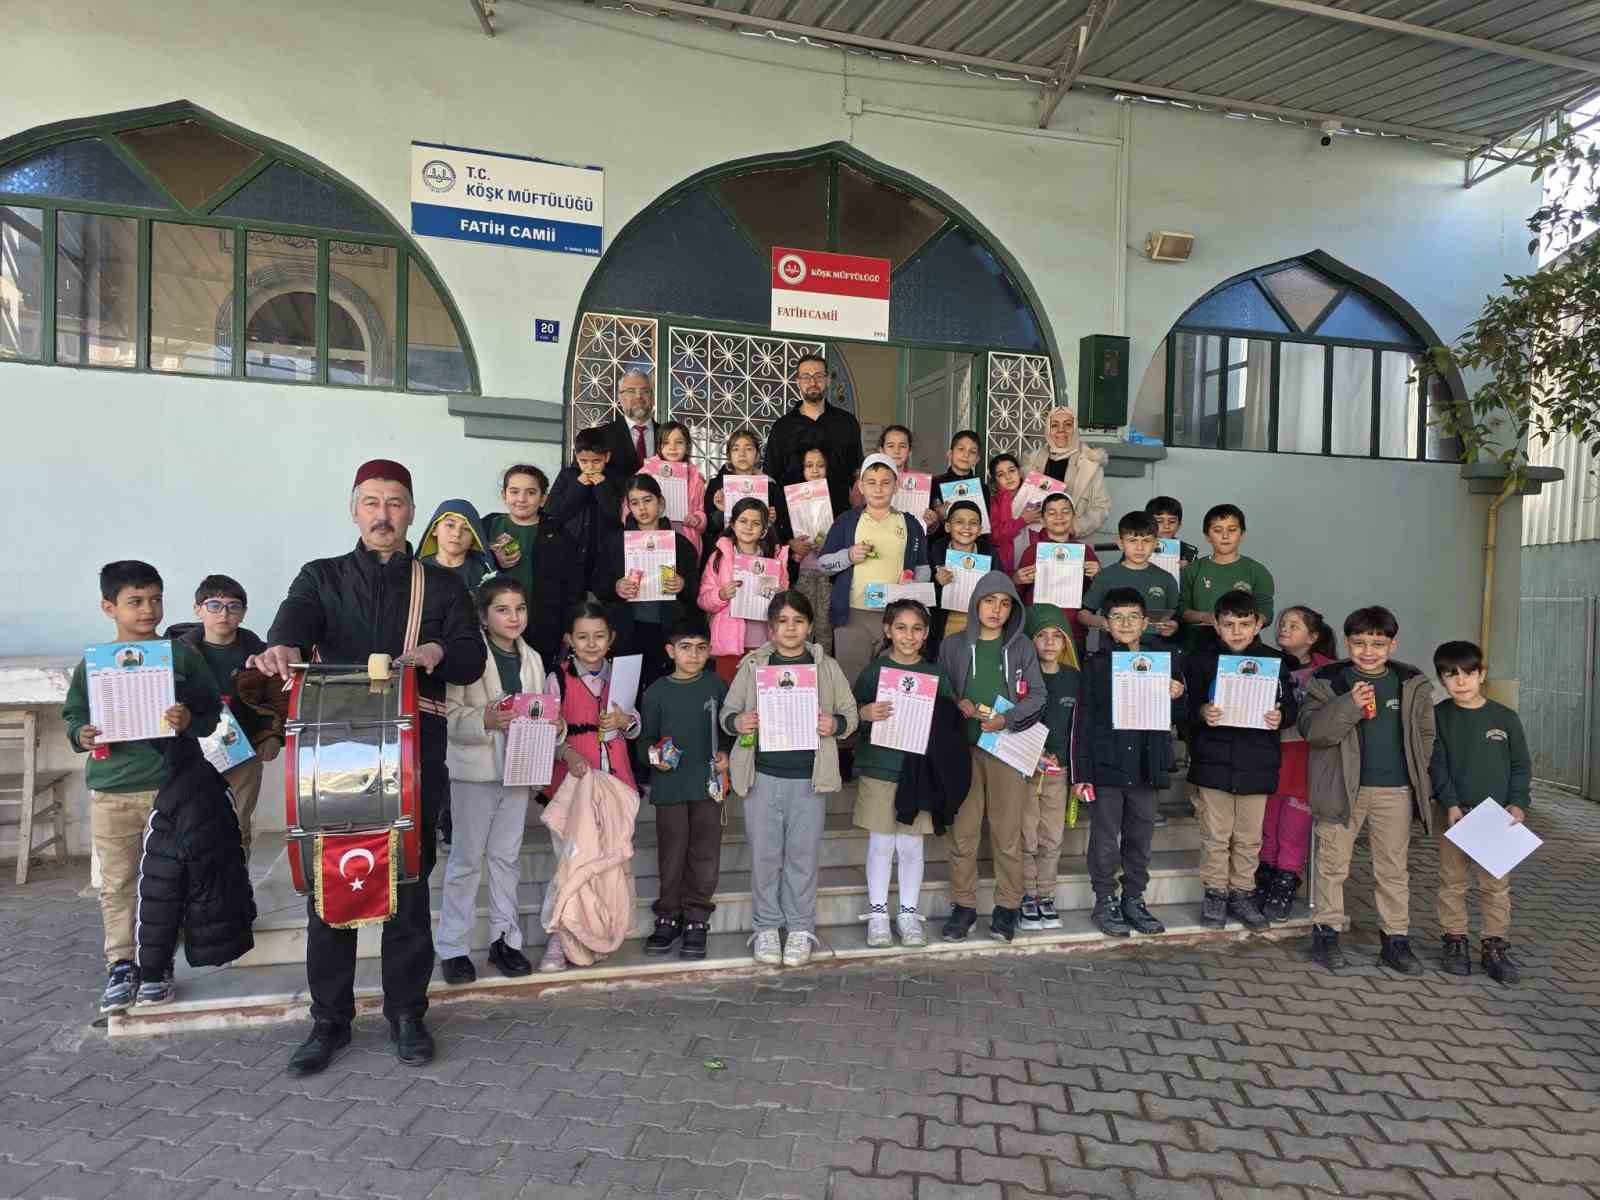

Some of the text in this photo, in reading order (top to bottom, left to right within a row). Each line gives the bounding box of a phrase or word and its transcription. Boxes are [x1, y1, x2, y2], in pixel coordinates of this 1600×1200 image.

[466, 167, 490, 180] T.C.
[466, 183, 593, 212] KÖŞK MÜFTÜLÜĞÜ
[460, 219, 556, 242] FATİH CAMİİ
[541, 322, 554, 334] 20
